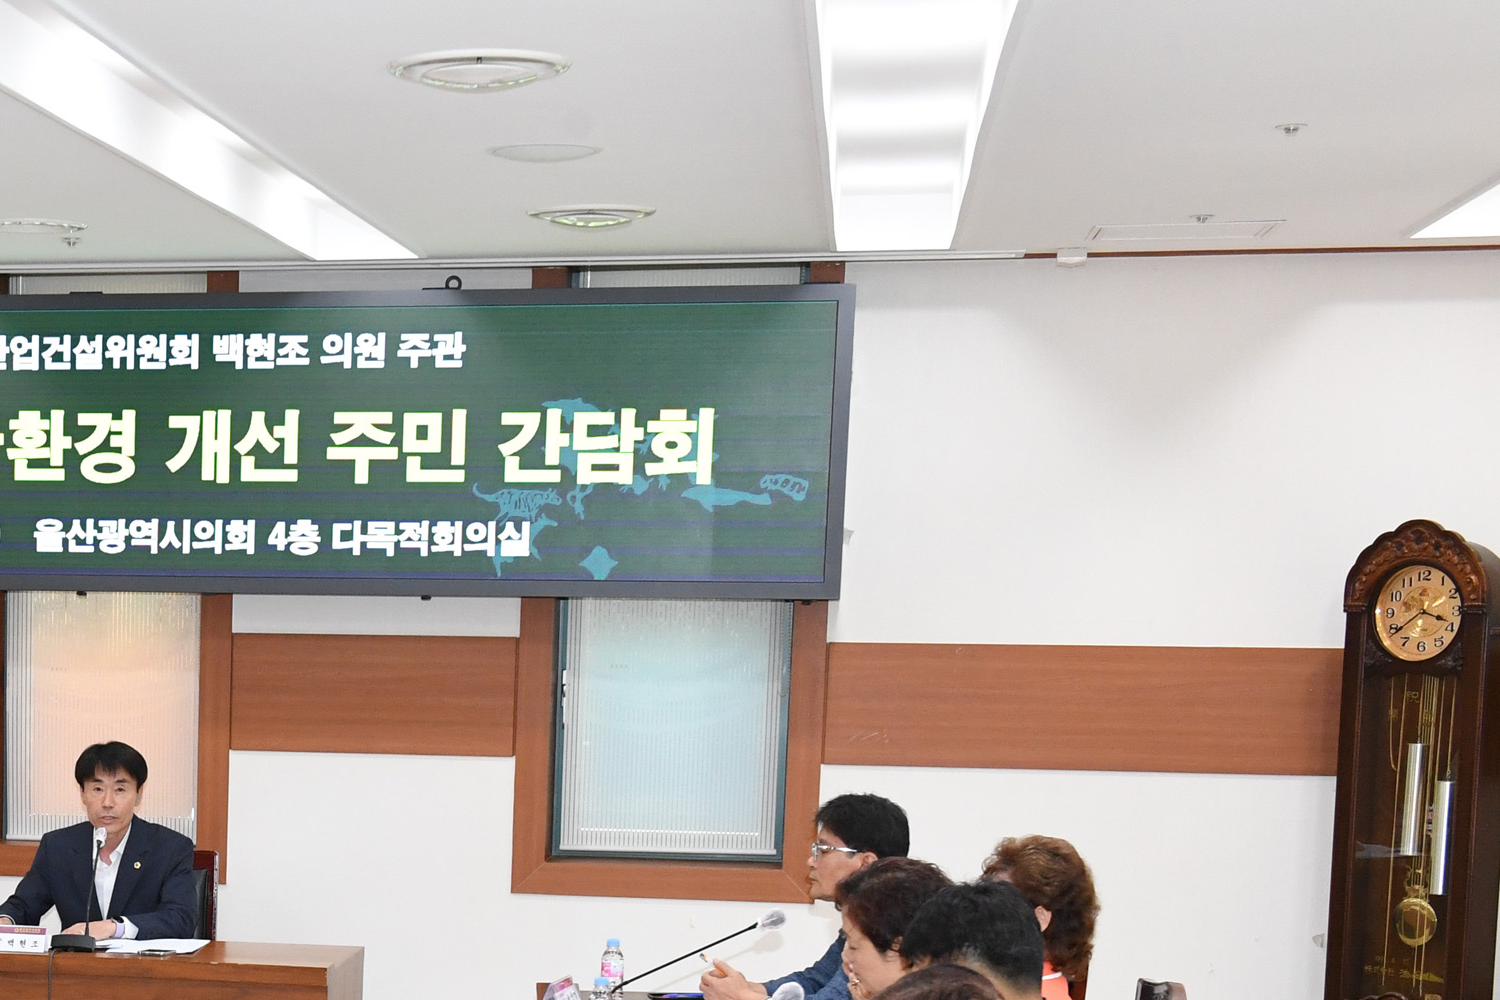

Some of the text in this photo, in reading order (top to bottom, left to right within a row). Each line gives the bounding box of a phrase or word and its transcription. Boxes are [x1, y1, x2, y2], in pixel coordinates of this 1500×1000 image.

[212, 333, 310, 369] 백현조
[320, 332, 387, 368] 의원
[397, 332, 466, 368] 주관
[165, 409, 300, 483] 개선
[326, 409, 468, 484] 주민
[498, 408, 715, 485] 간담회
[33, 518, 256, 554] 울산광역시의회
[268, 520, 321, 555] 4층
[331, 520, 531, 557] 다목적회의실
[1418, 570, 1432, 581] 12
[1402, 576, 1413, 588] 11
[1390, 590, 1403, 602] 10
[1449, 588, 1459, 599] 2
[1386, 607, 1395, 618] 9
[1452, 605, 1461, 616] 3
[1389, 623, 1399, 634] 8
[1445, 622, 1455, 633] 4
[1400, 636, 1410, 647] 7
[1416, 641, 1427, 652] 6
[1434, 636, 1445, 648] 5
